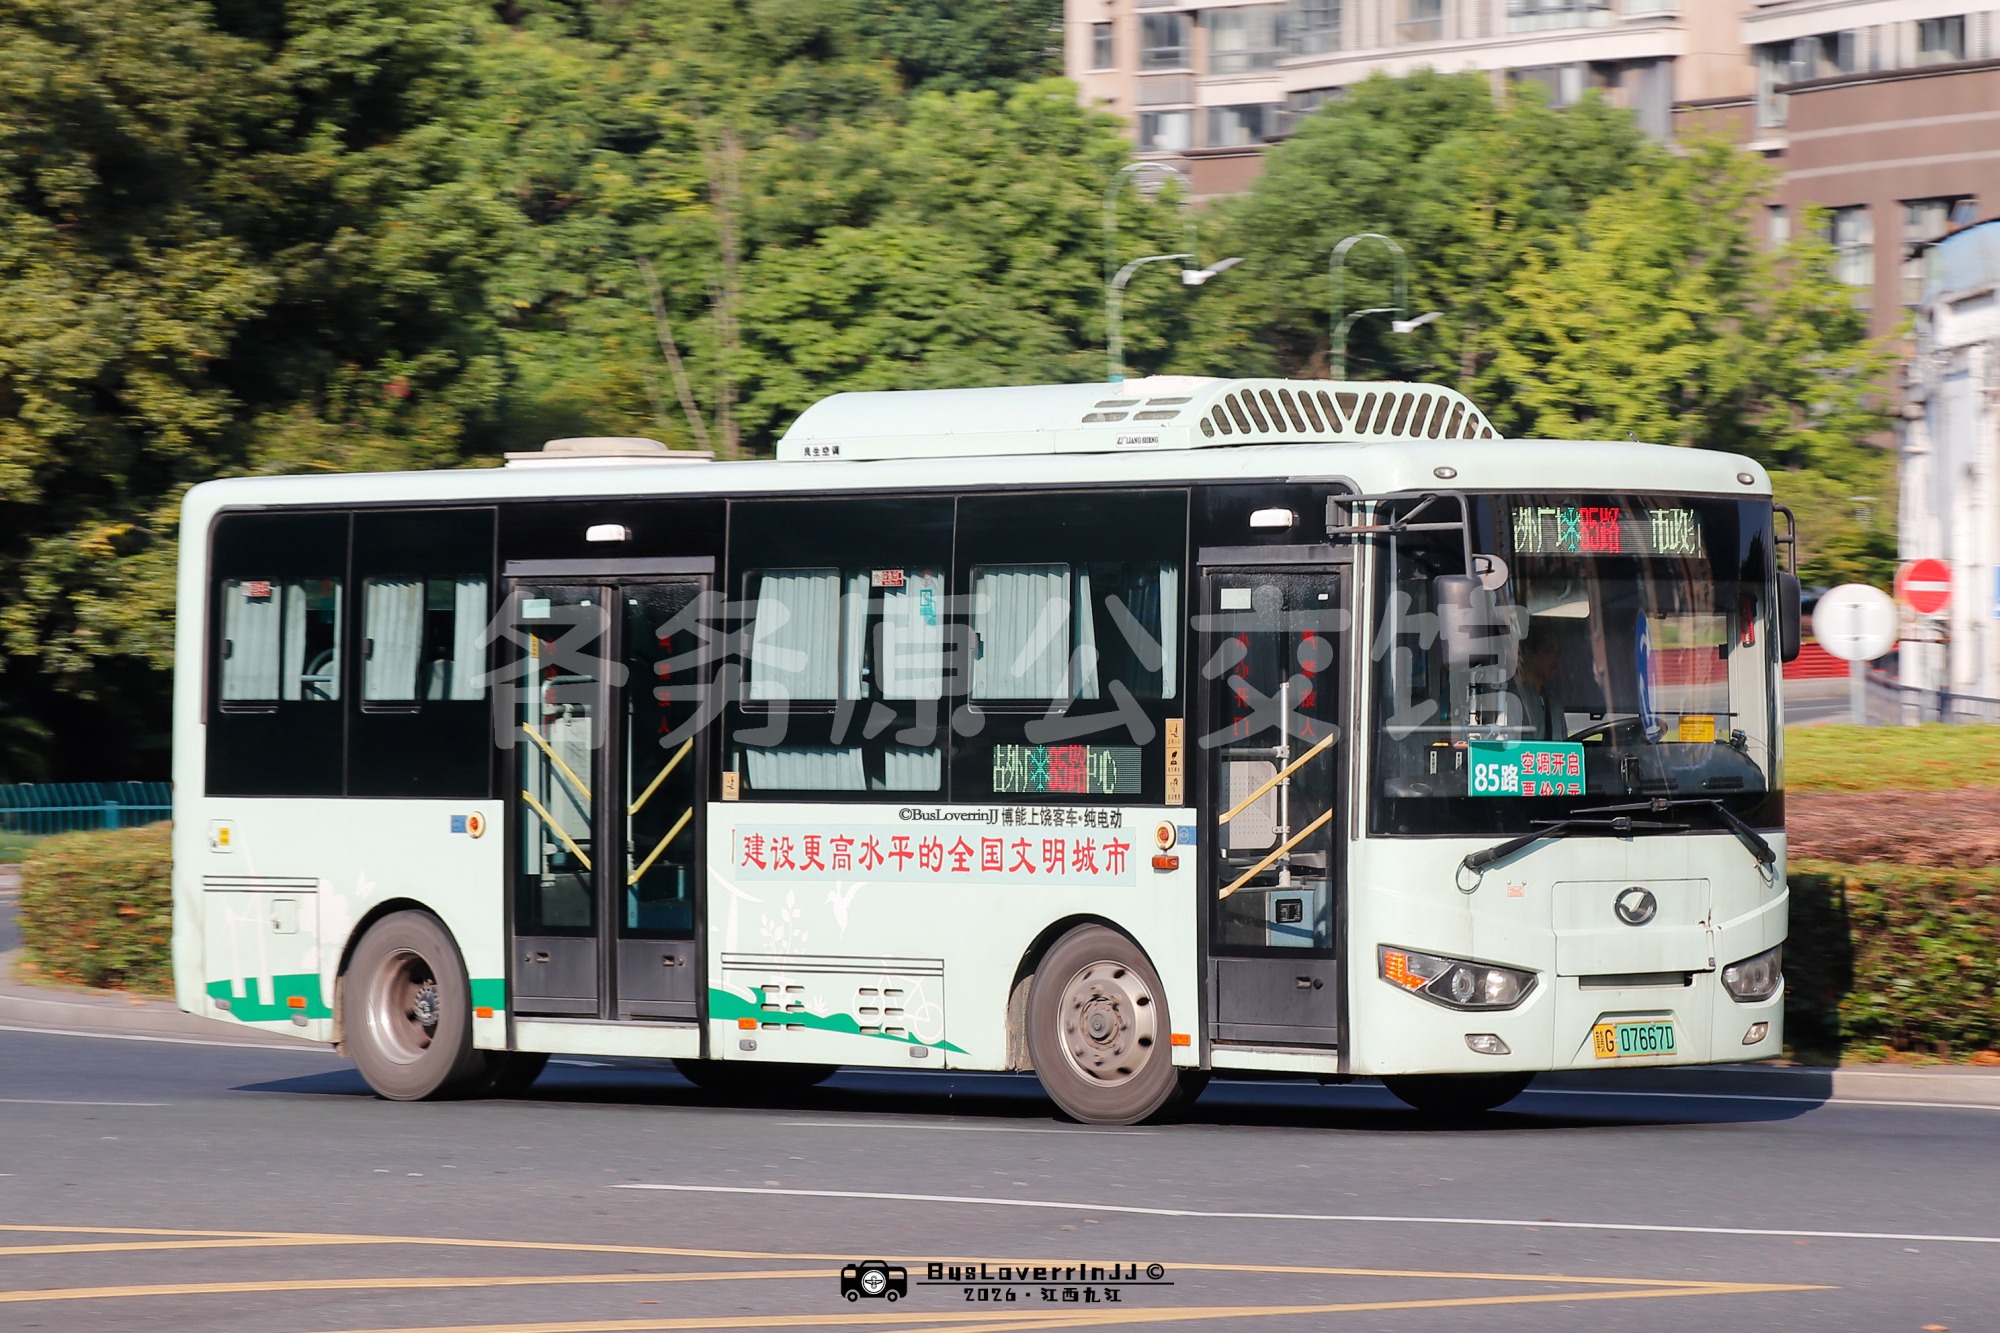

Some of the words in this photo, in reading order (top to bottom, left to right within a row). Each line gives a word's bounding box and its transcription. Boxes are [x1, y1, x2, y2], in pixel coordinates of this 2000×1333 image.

[1521, 752, 1580, 776] 空调开启
[1474, 763, 1519, 793] 85路
[741, 832, 1131, 876] 建设更高水平的全国文明城市
[1621, 1026, 1674, 1051] 07667D
